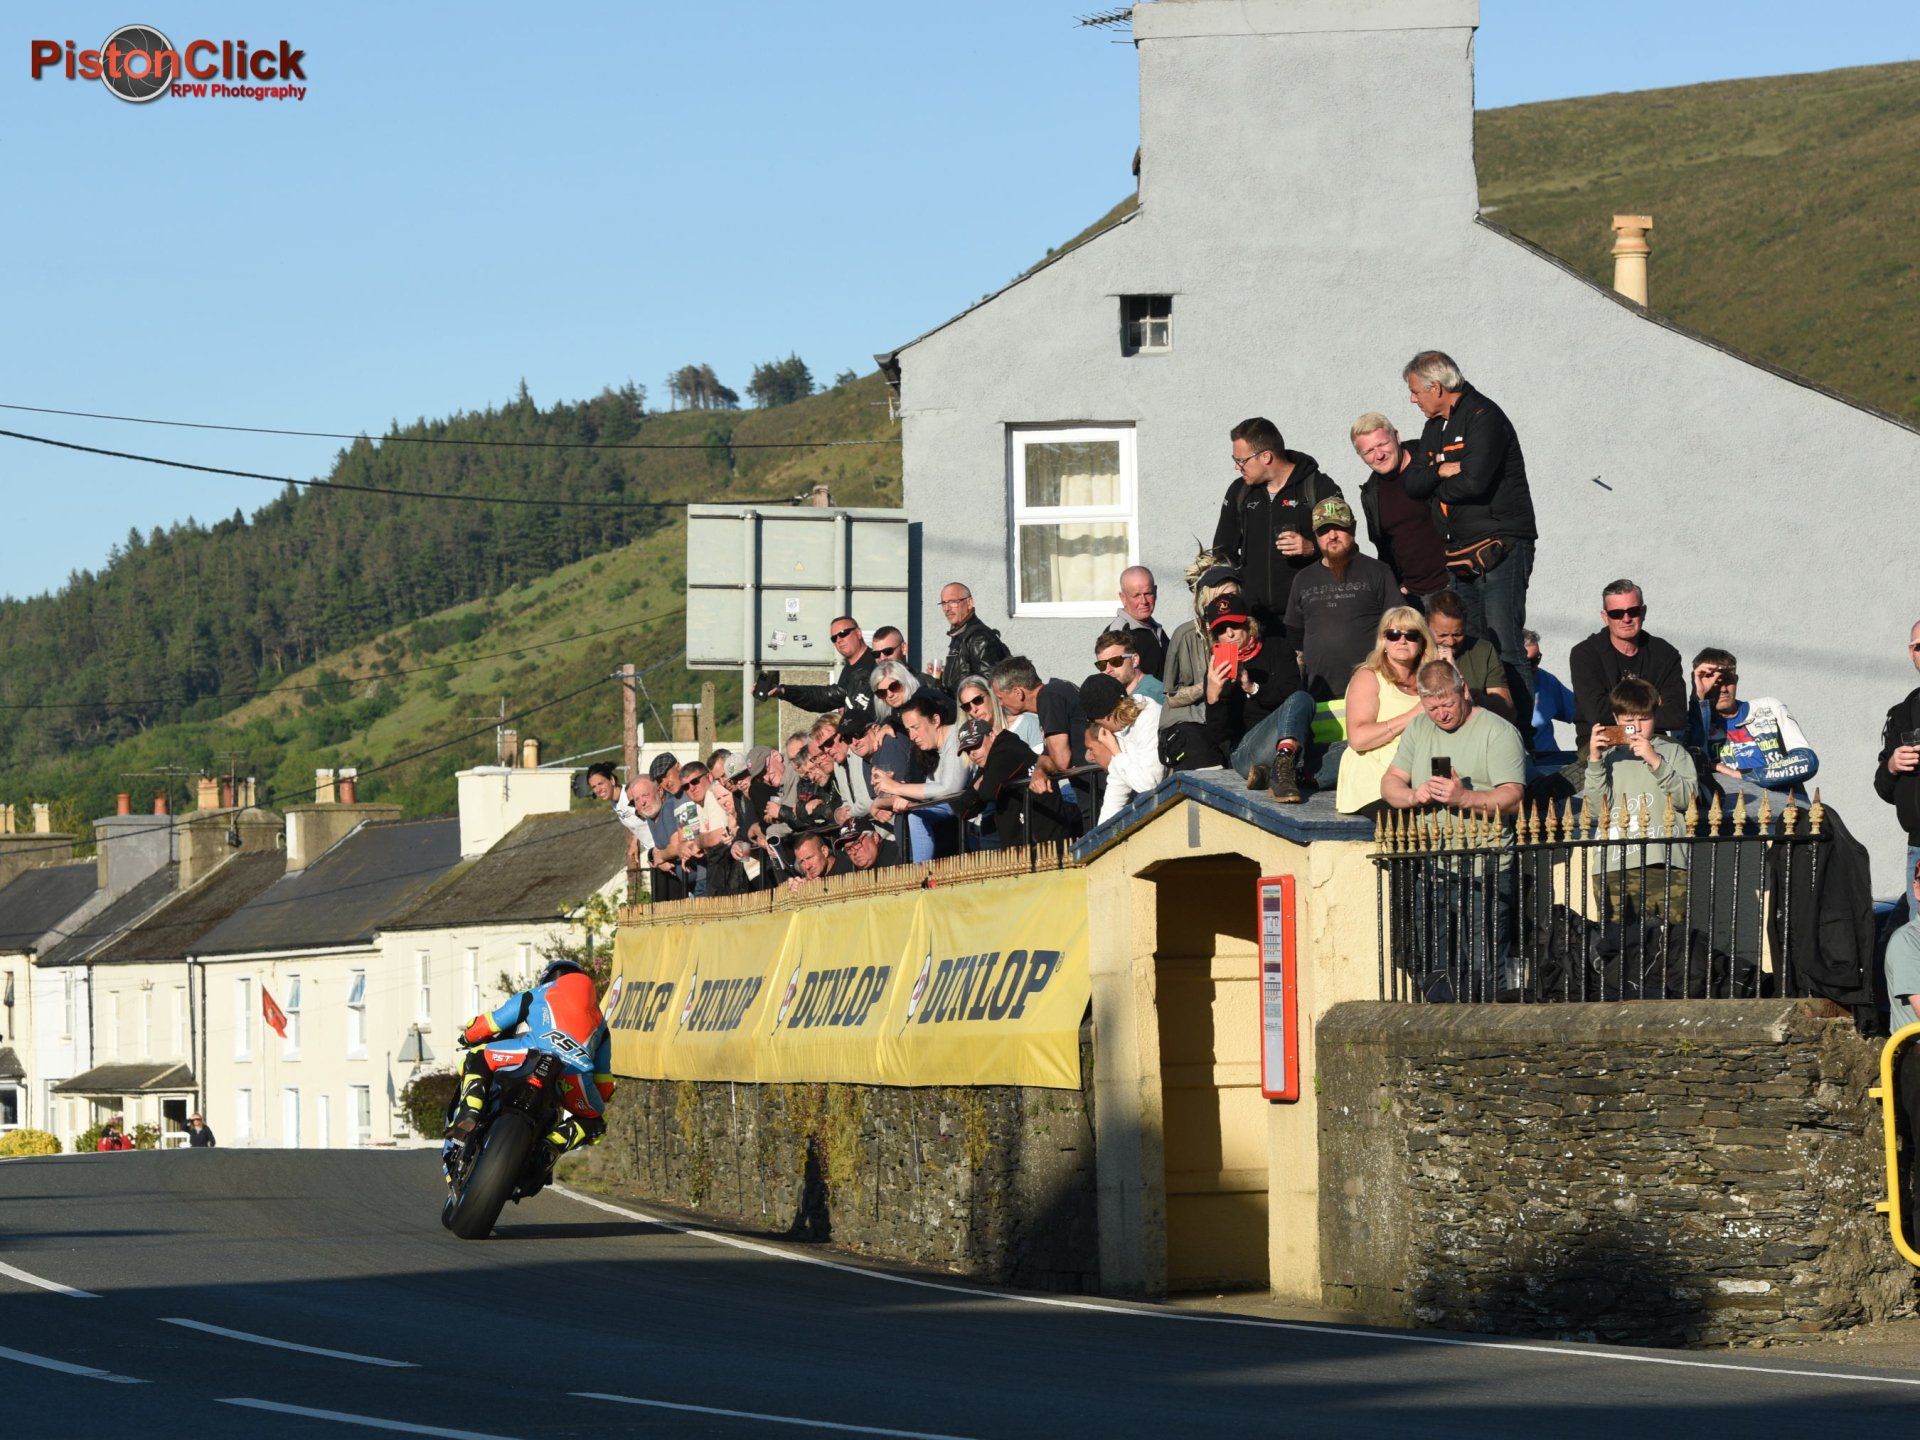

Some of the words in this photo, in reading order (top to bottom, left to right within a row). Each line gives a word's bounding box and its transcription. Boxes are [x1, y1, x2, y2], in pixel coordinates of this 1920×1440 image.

[1765, 764, 1809, 779] MoviStar
[787, 965, 890, 1029] DUNLOP
[918, 950, 1060, 1024] DUNLOP
[492, 1053, 514, 1063] RST
[539, 1029, 592, 1060] RST
